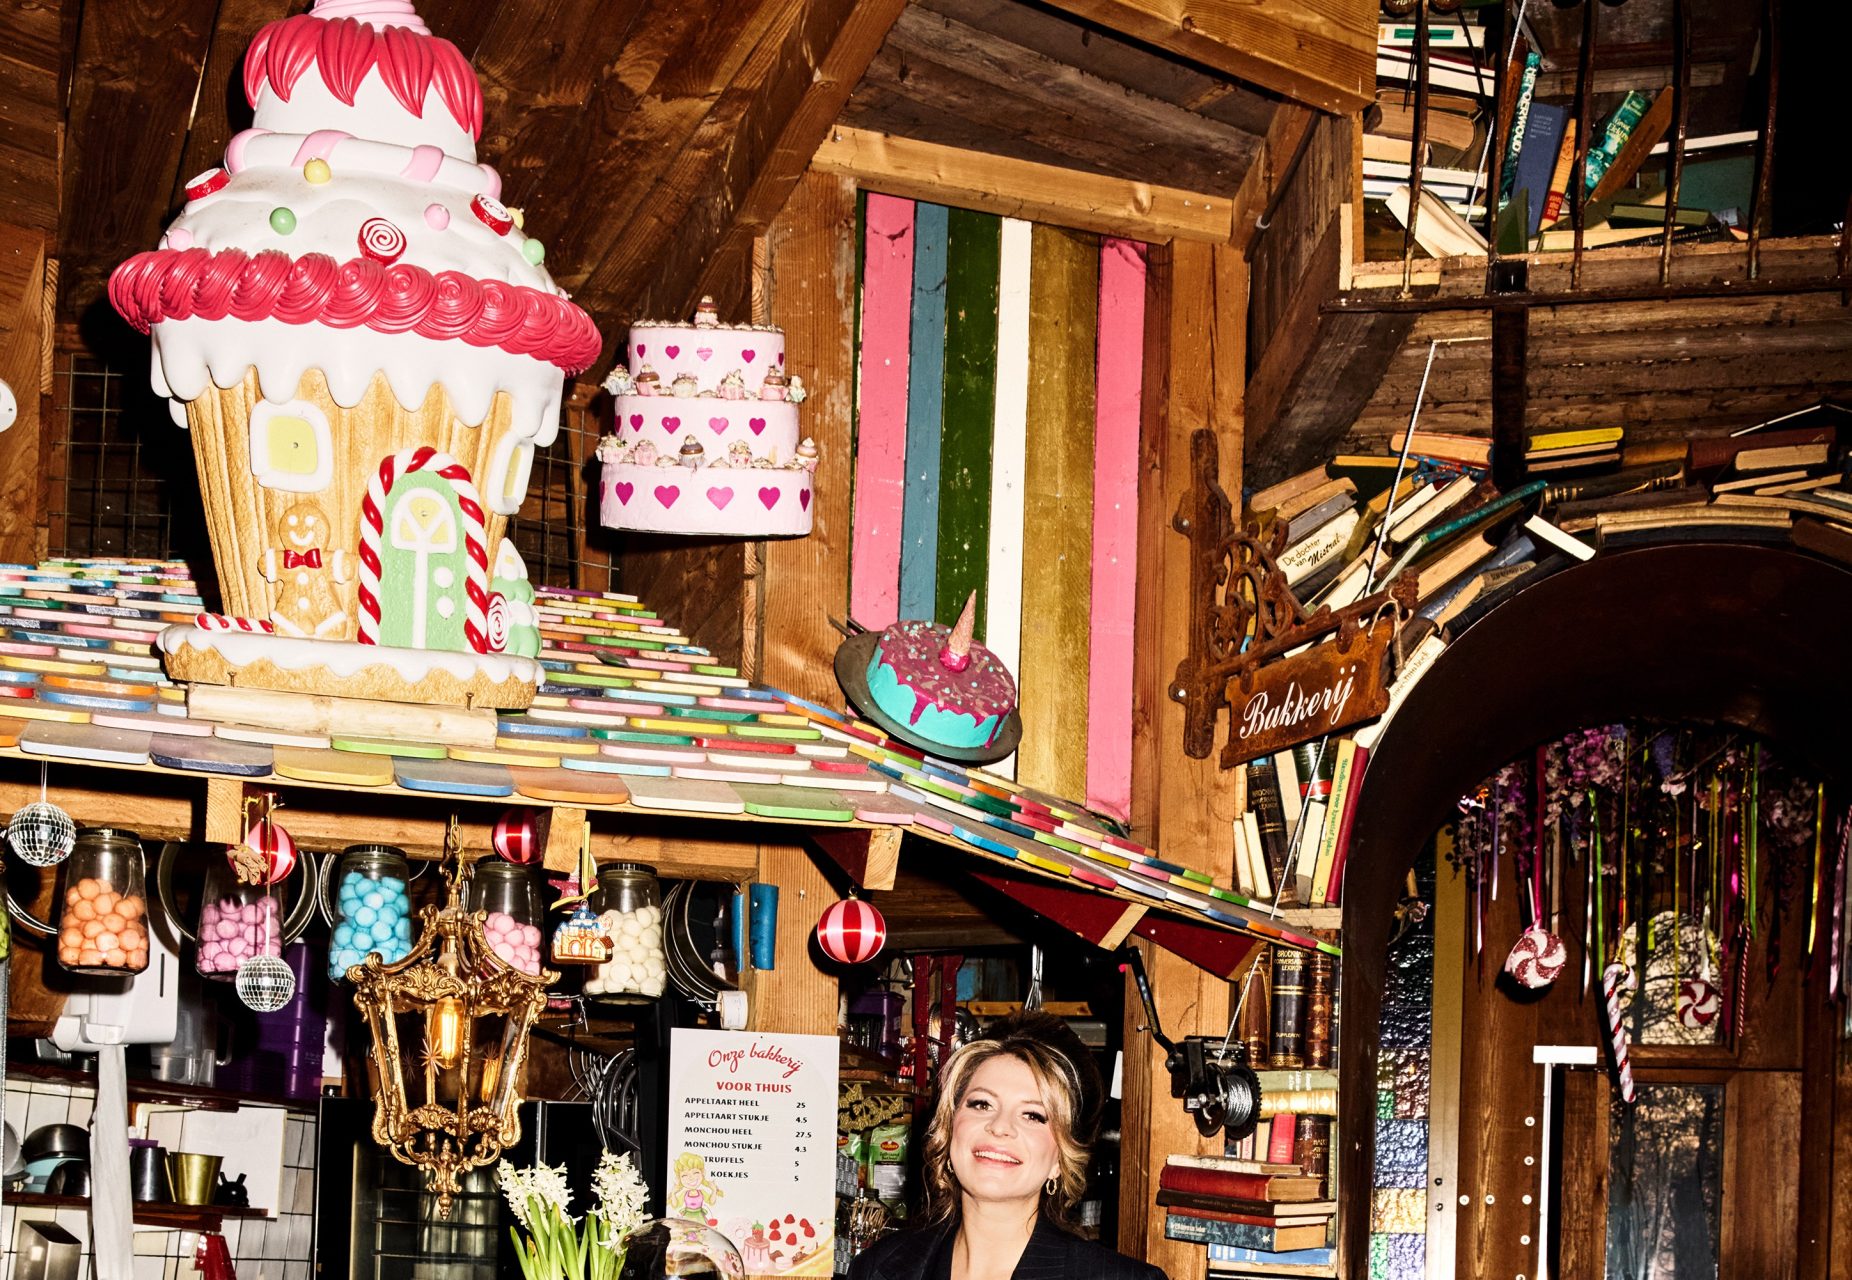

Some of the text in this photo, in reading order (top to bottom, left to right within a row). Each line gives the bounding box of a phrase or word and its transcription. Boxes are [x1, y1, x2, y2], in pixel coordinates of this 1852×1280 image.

[1512, 93, 1532, 153] OERWOUD
[1282, 538, 1320, 567] De dochter
[1294, 532, 1341, 568] van Mistral
[1239, 665, 1357, 740] Bakkerij
[708, 1042, 804, 1079] Onze bakkerij
[716, 1081, 792, 1093] VOOR THUIS
[684, 1097, 737, 1106] APPELTAART
[684, 1112, 737, 1120] APPELTAART
[738, 1114, 769, 1122] STUKJE
[684, 1126, 730, 1134] MONCHOU
[795, 1131, 812, 1139] 27.5
[684, 1141, 730, 1149] MONCHOU
[732, 1142, 762, 1150] STUKJE
[704, 1156, 744, 1164] TRUFFELS
[710, 1170, 749, 1178] KOEKJES
